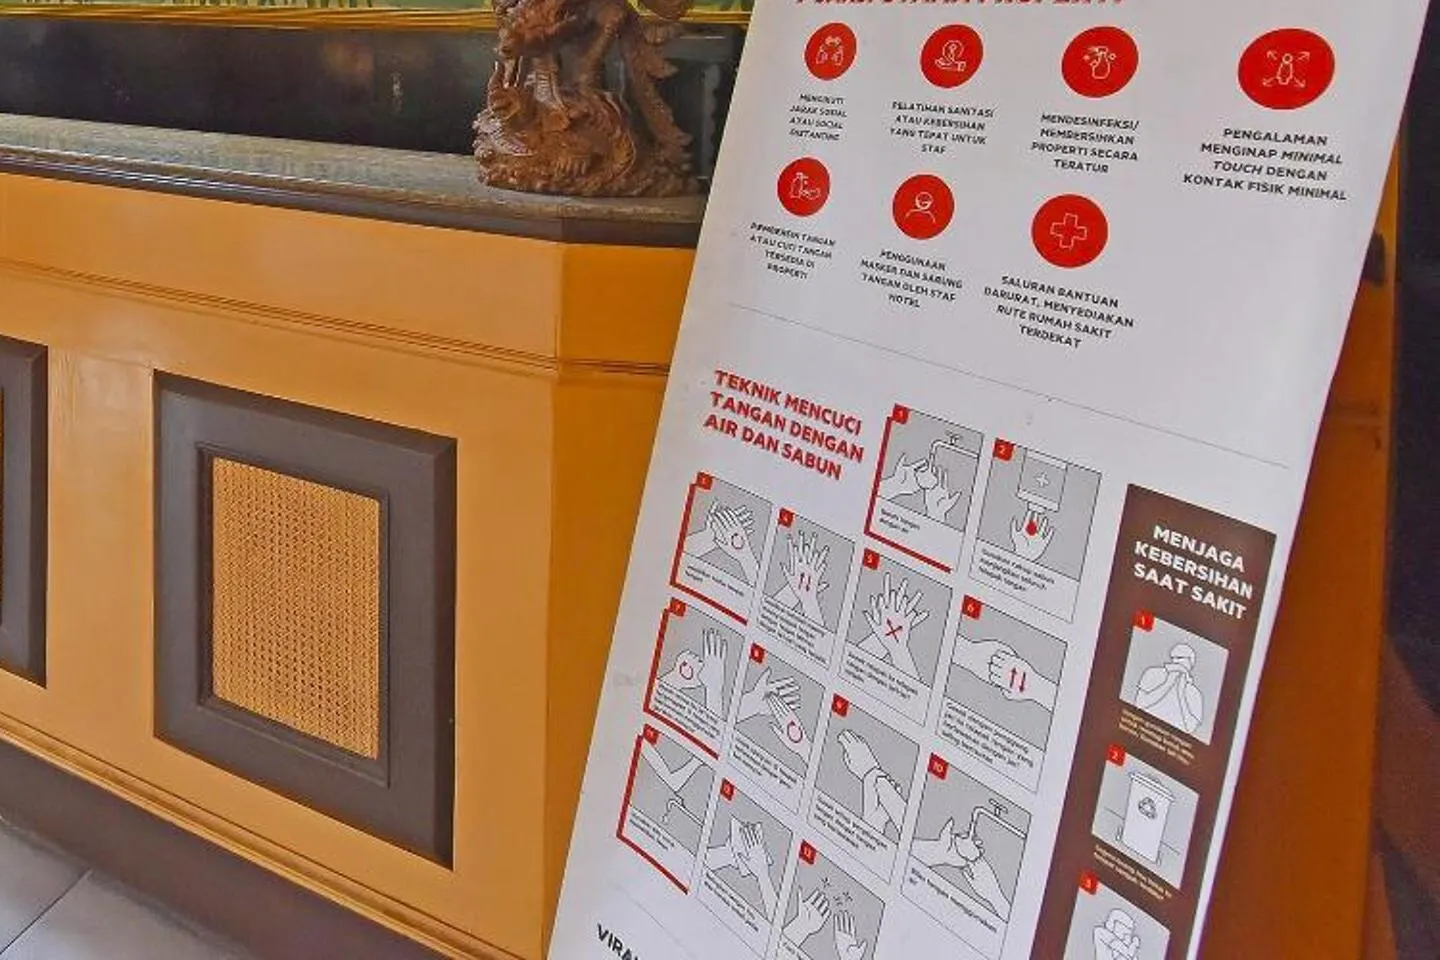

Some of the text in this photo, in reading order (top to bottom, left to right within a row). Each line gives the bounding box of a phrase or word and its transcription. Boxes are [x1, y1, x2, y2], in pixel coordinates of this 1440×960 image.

[892, 101, 945, 114] PELATIHAN
[895, 114, 922, 125] ATAU
[921, 143, 946, 153] STAF
[1040, 127, 1135, 145] MEMBERSIHKAN
[1223, 127, 1328, 146] PENGALAMAN
[1031, 141, 1138, 161] PROPERTI SECARA
[1200, 142, 1343, 165] MENGINAP MINIMAL
[1053, 158, 1109, 173] TERATUR
[1213, 160, 1328, 181] TOUCH DENGAN
[1183, 174, 1347, 201] KONTAK FISIK MINIMAL
[930, 289, 956, 302] STAF
[1000, 275, 1119, 308] SALURAN BANTUAN
[996, 304, 1113, 339] RUTE RUMAH SAKIT
[1043, 300, 1135, 328] MENYEDIAKAN
[1019, 324, 1082, 349] TERDEKAT
[714, 369, 862, 436] TEKNIK MENCUCI
[710, 391, 864, 463] TANGAN DENGAN
[704, 414, 842, 480] AIR DAN SABUN
[1153, 525, 1245, 573] MENJAGA
[1134, 541, 1253, 600] KEBERSIHAN
[1134, 563, 1247, 620] SAAT SAKIT
[597, 923, 639, 960] VIRA
